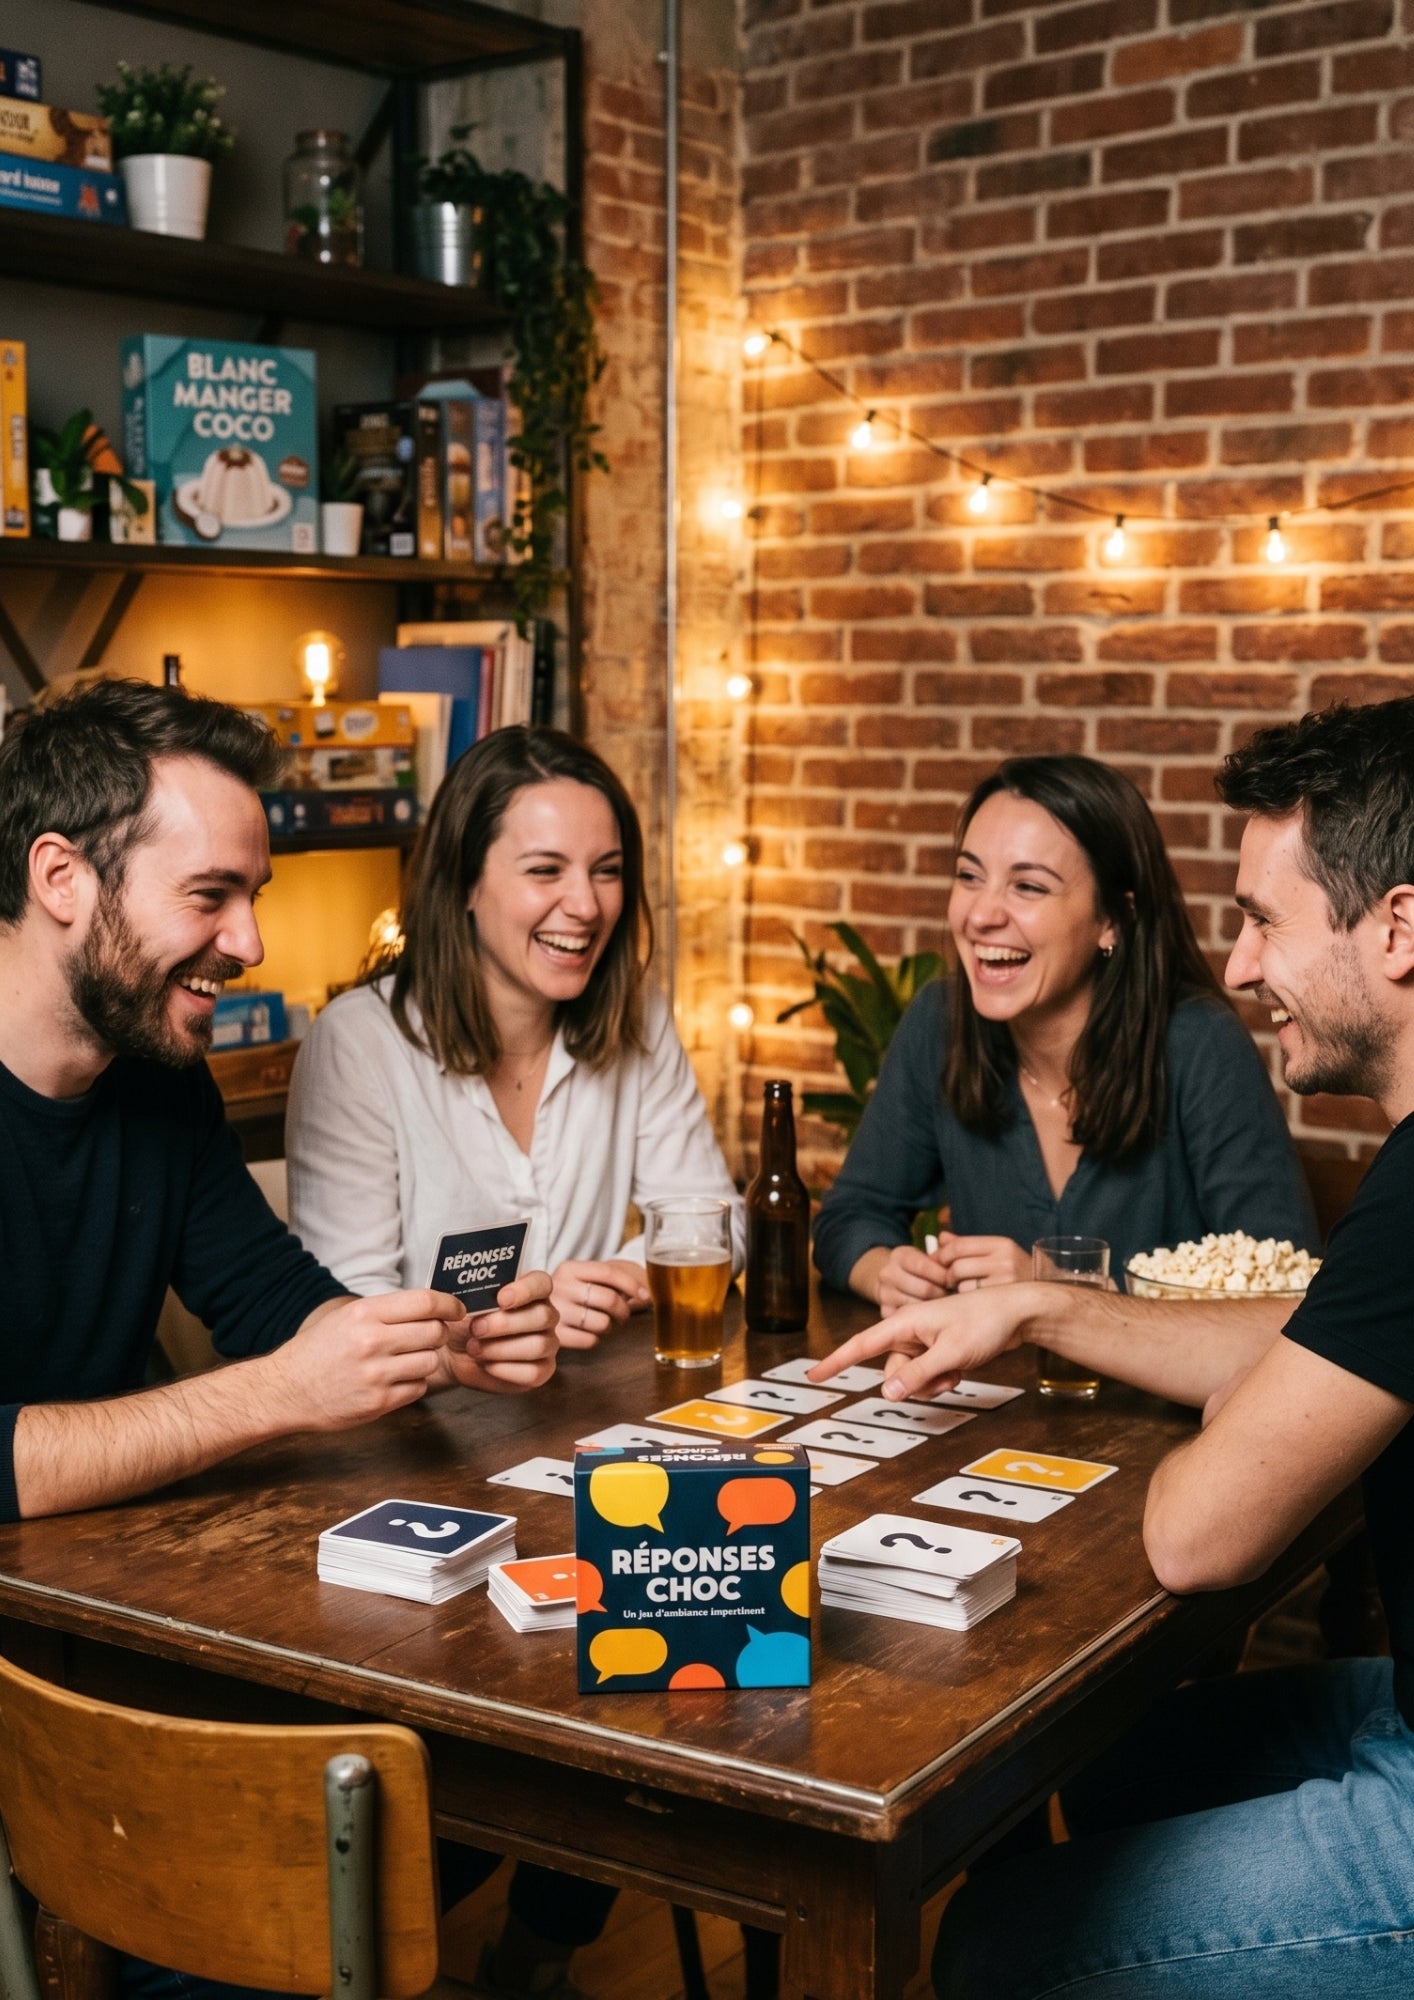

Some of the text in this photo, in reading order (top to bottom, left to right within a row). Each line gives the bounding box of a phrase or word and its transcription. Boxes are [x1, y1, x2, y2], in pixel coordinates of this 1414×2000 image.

[186, 352, 278, 386] BLANC
[173, 381, 292, 415] MANGER
[193, 411, 275, 442] COCO
[442, 1245, 515, 1271] RÉPONSES
[457, 1265, 498, 1285] CHOC
[612, 1540, 776, 1575] RÉPONSES
[646, 1575, 742, 1603] CHOC
[623, 1606, 766, 1620] Un jeu d'ambiance impertinent
